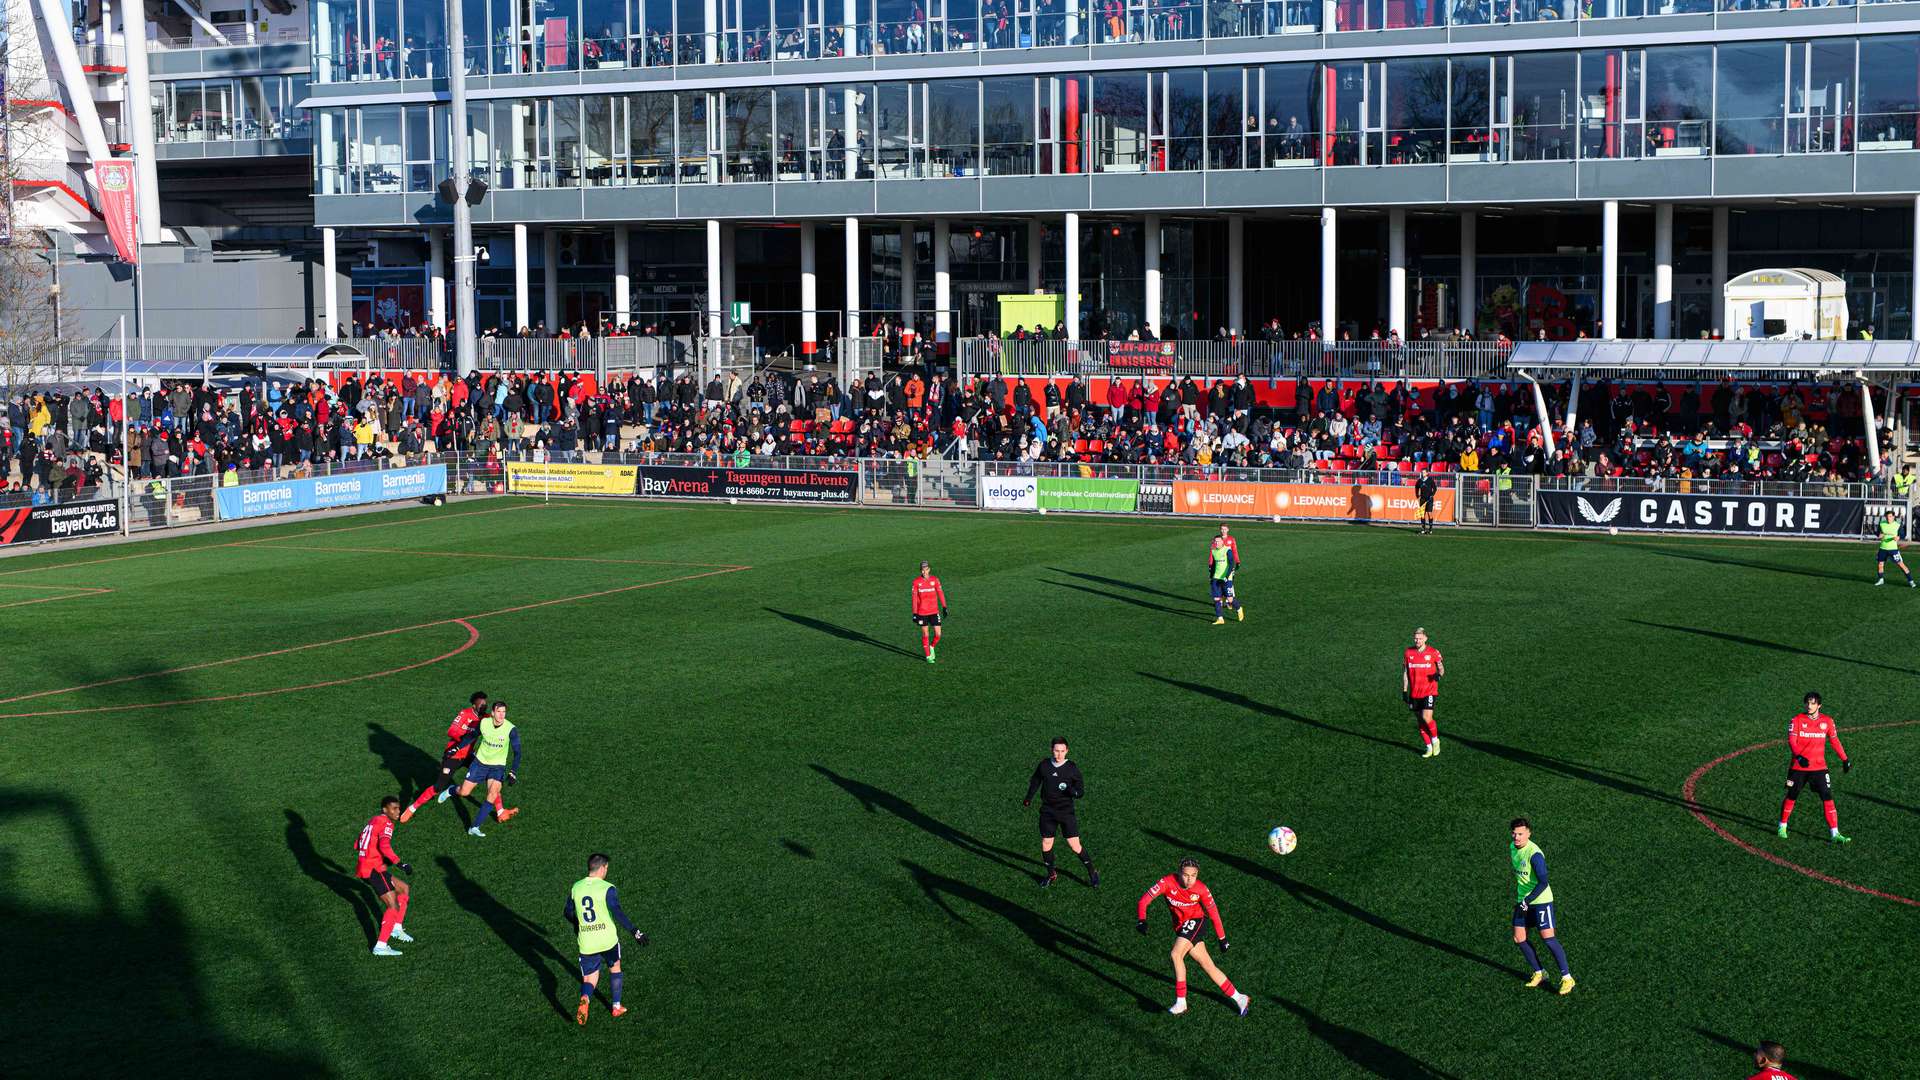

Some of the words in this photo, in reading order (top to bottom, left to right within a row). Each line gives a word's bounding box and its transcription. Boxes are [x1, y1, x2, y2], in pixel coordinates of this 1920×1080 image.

[383, 471, 425, 488] Barmenia
[643, 477, 709, 495] BayArena
[726, 470, 782, 485] Tagungen
[784, 472, 806, 485] und
[810, 473, 849, 486] Events
[243, 485, 292, 504] Barmenia
[315, 478, 361, 496] Barmenia
[725, 486, 780, 496] 0214-8660-777
[783, 488, 849, 499] bayarena-plus.de
[988, 484, 1025, 500] reloga
[1050, 490, 1082, 499] regionaler
[1203, 493, 1255, 504] LEDVANCE
[1293, 496, 1347, 507] LEDVANCE
[62, 505, 96, 516] ANMELDUNG
[96, 503, 116, 513] UNTER:
[1640, 499, 1821, 529] CASTORE
[51, 512, 116, 535] bayer04.de
[581, 895, 597, 922] 3
[1538, 910, 1546, 922] 7
